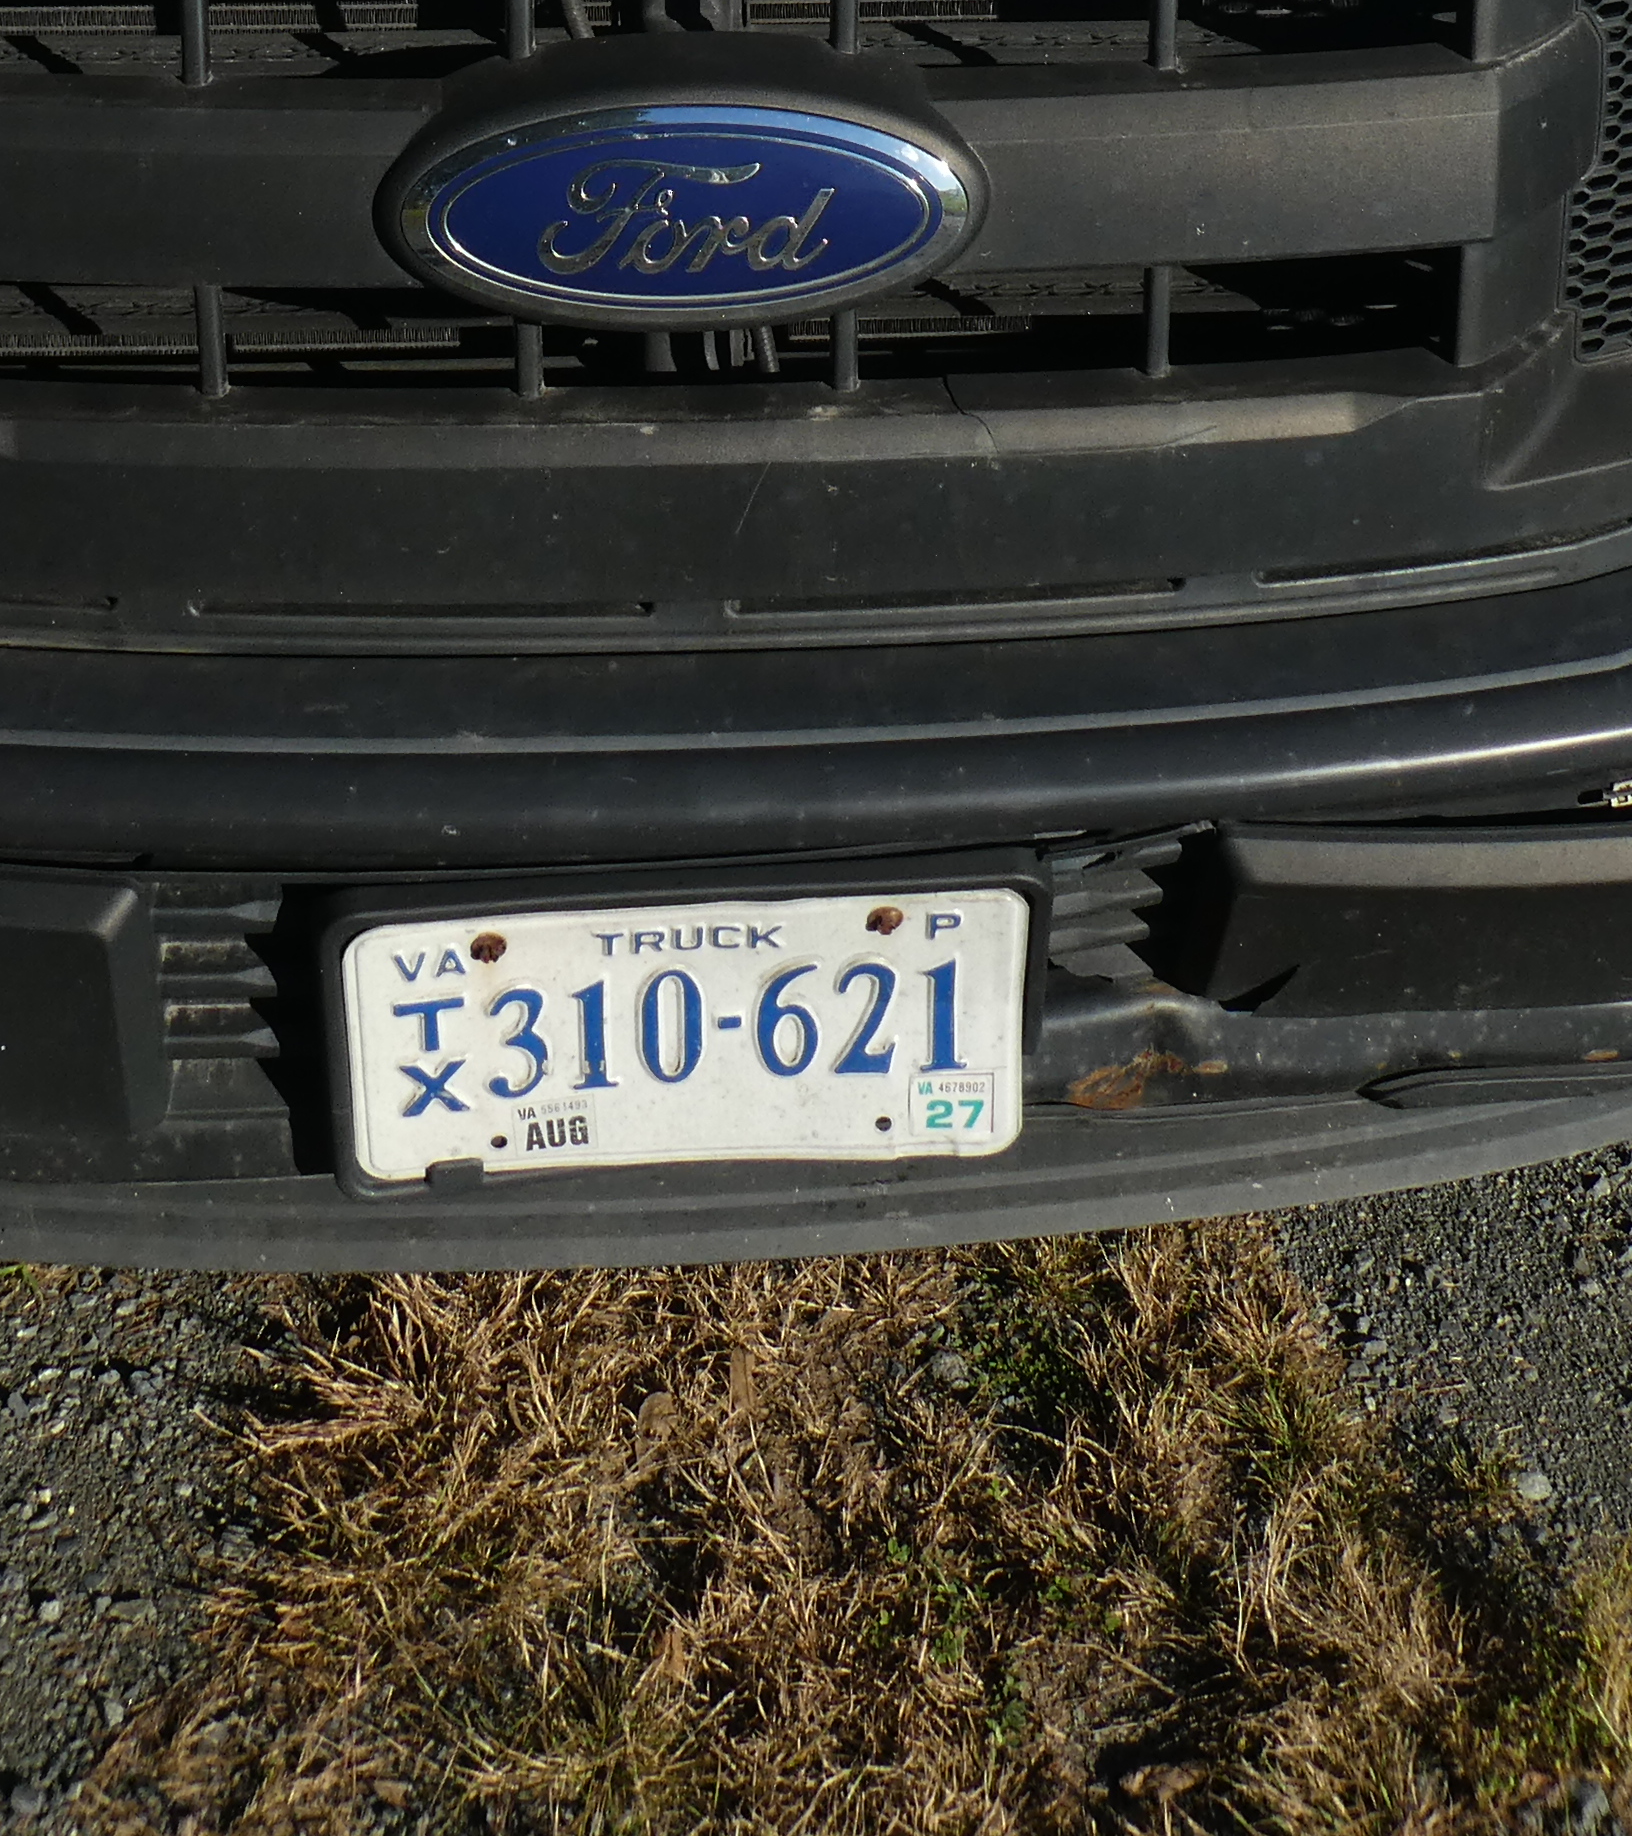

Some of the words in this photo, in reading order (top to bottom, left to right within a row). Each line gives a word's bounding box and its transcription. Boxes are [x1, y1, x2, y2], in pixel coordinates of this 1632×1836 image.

[537, 159, 835, 274] Ford
[597, 925, 783, 956] TRUCK
[926, 913, 962, 940] P
[393, 948, 466, 981] VA
[483, 957, 968, 1099] 310-621
[917, 1081, 933, 1095] VA
[517, 1107, 536, 1120] VA
[925, 1099, 984, 1129] 27
[526, 1115, 589, 1151] AUG
